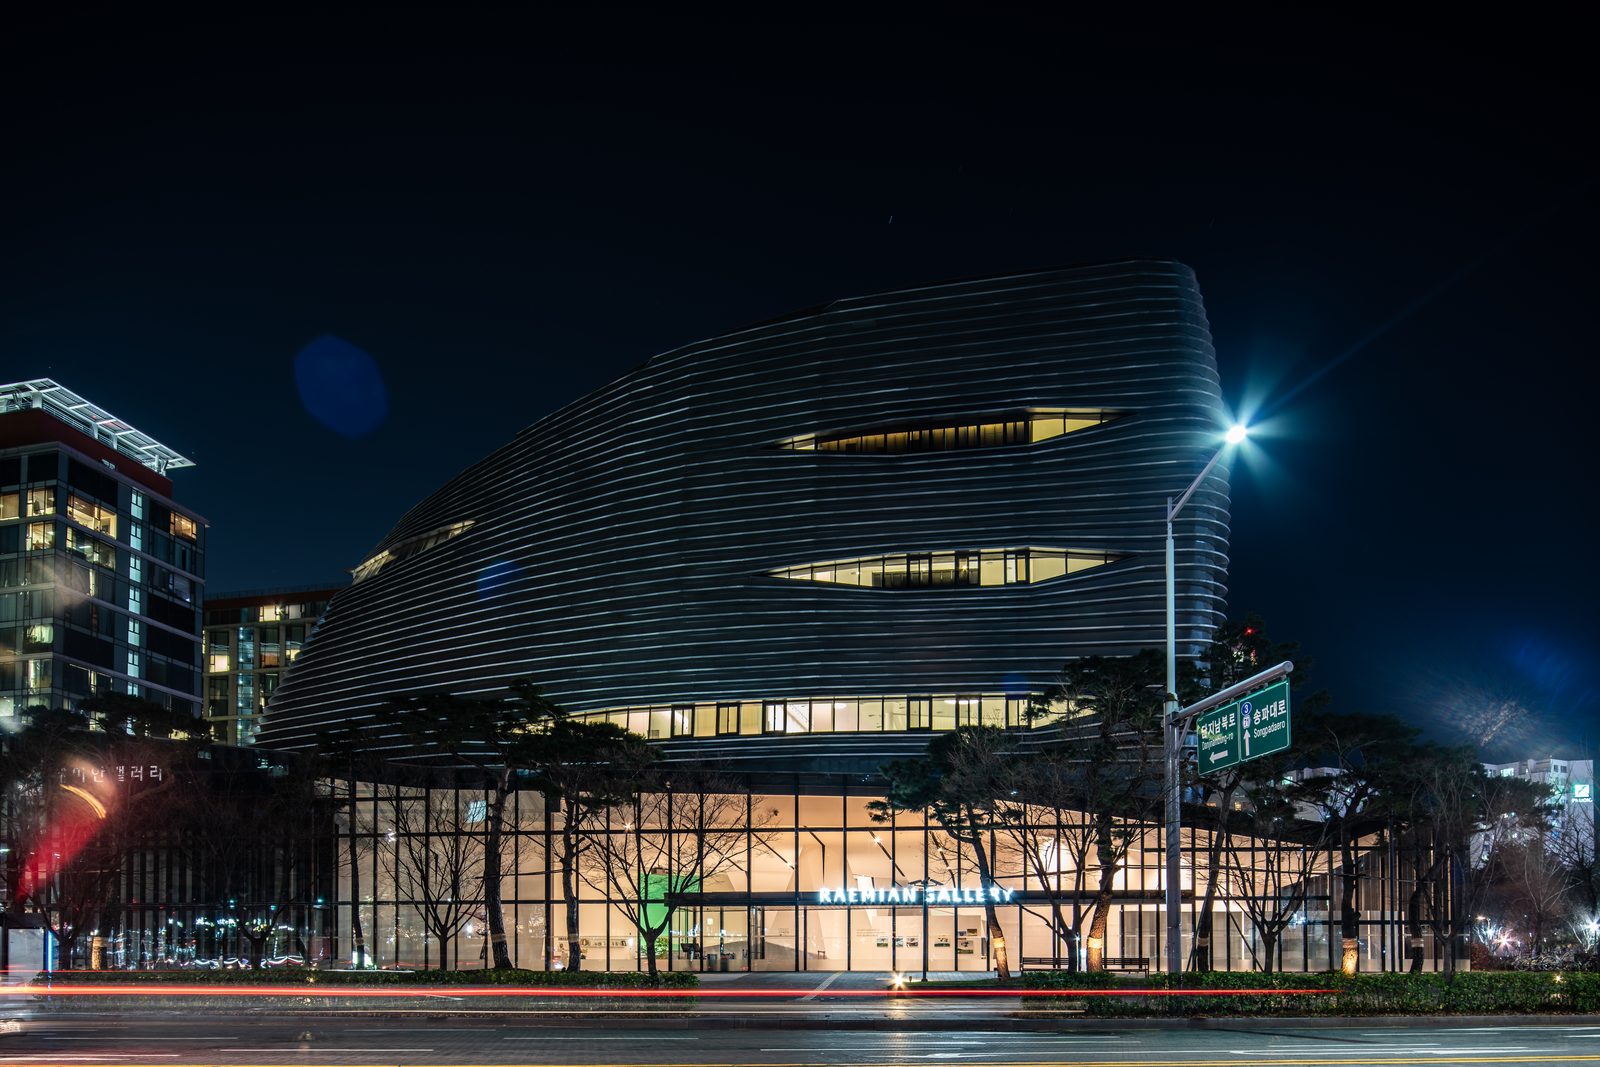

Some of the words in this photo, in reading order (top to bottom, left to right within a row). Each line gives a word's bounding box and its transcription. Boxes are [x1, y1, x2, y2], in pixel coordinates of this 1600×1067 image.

[1253, 699, 1286, 725] 송파대로
[1253, 720, 1286, 738] Songpadaero
[115, 765, 163, 782] 갤러리
[819, 887, 917, 903] RAEMIAN
[924, 887, 1014, 903] GALLERY
